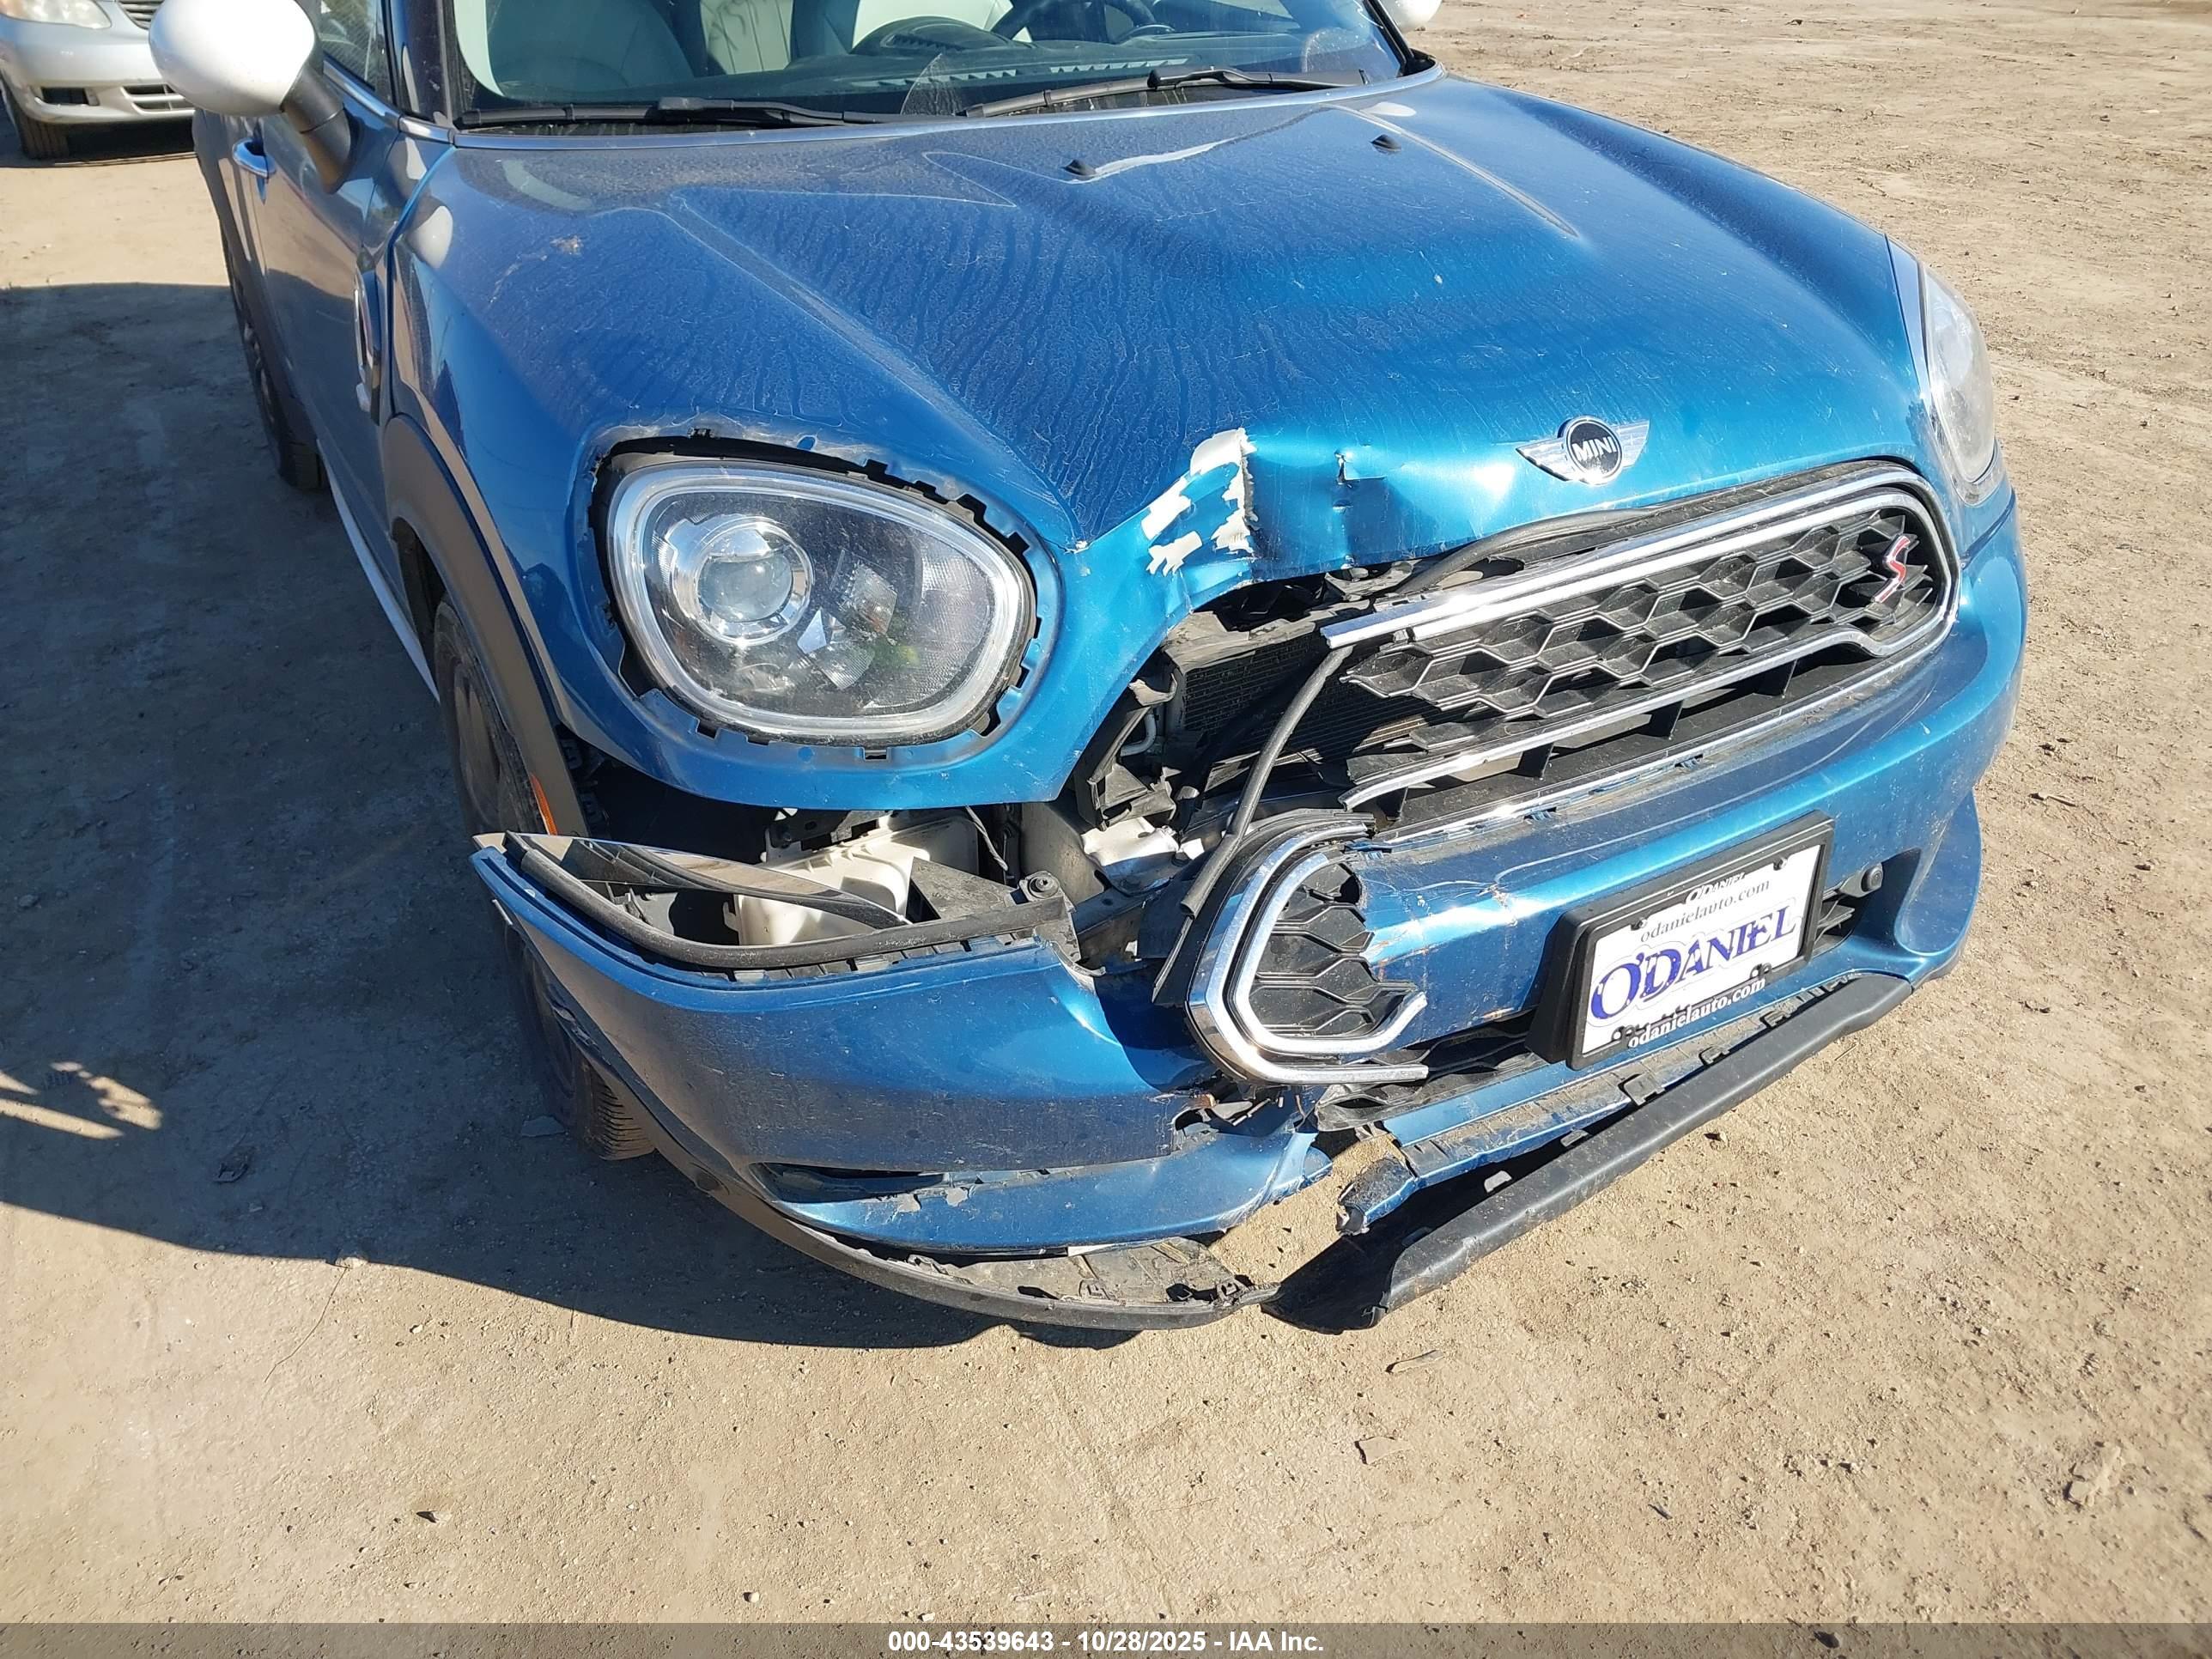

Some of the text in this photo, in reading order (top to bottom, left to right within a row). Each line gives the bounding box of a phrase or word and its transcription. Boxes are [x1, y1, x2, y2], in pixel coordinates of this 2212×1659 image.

[1571, 435, 1619, 462] MINI
[1640, 880, 1771, 944] odanielauto.com
[1590, 905, 1797, 1021] O'DANIEL
[1628, 977, 1766, 1048] odanielauto.com
